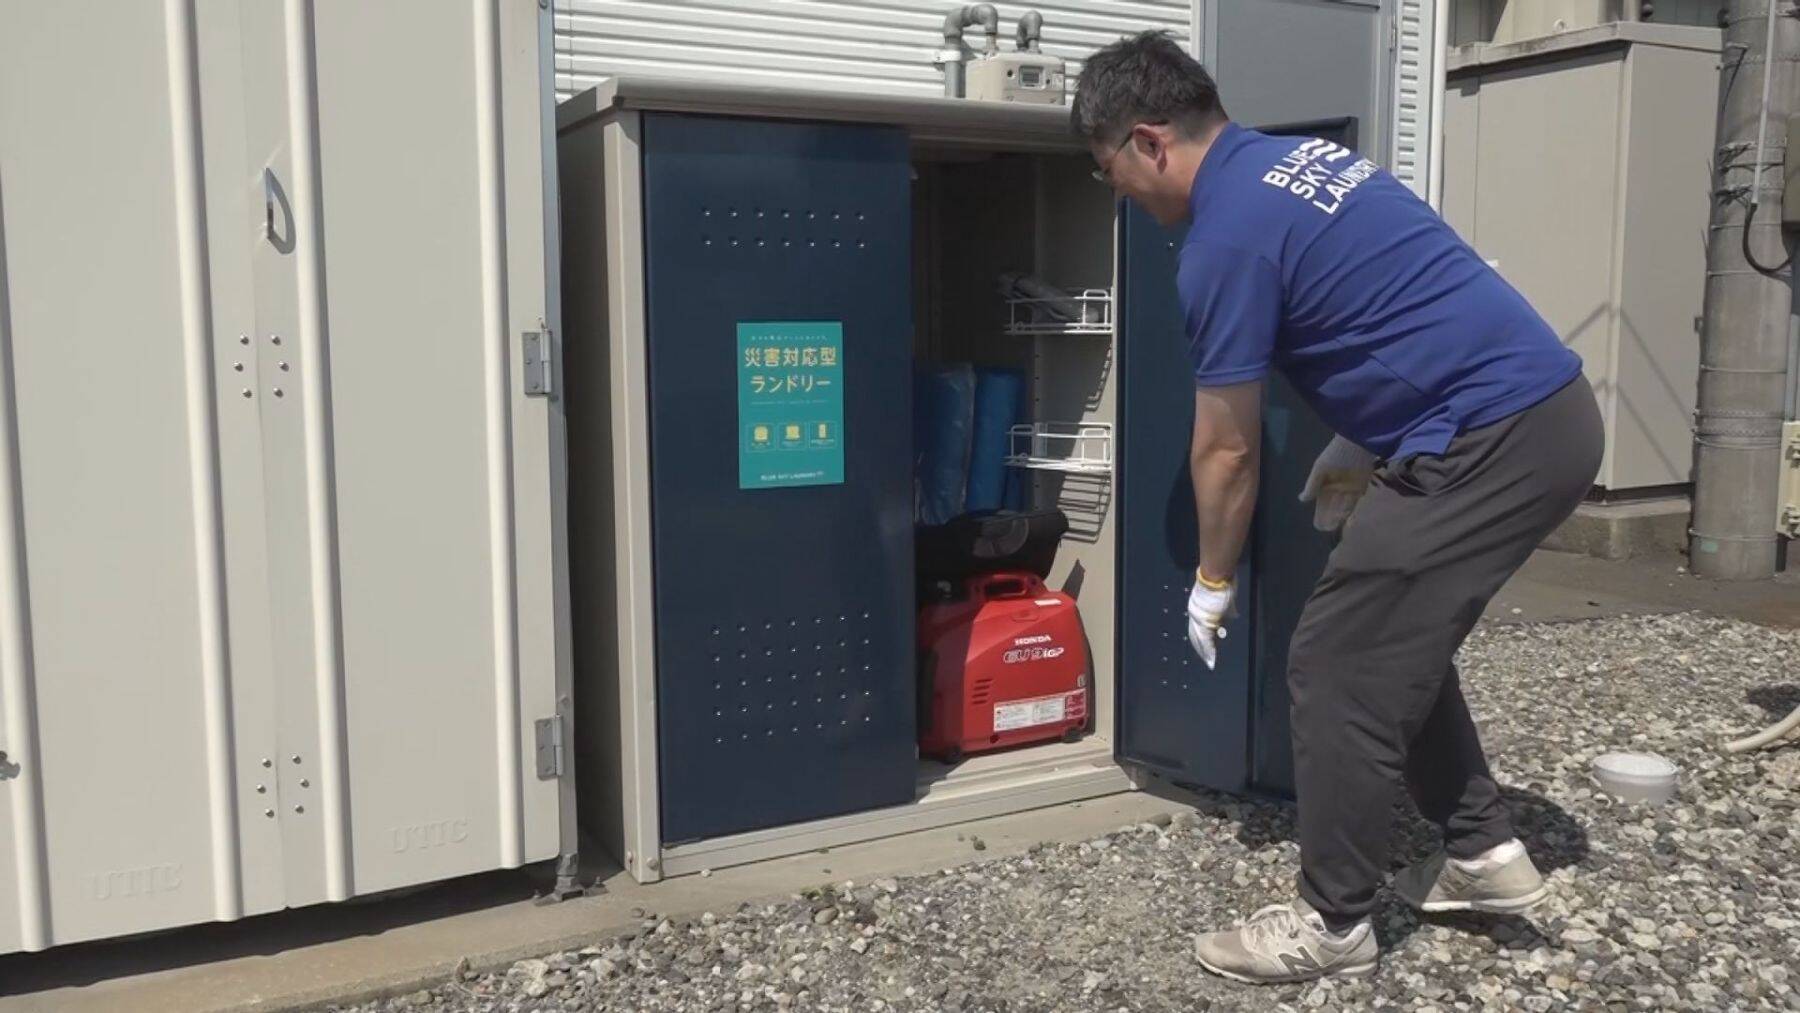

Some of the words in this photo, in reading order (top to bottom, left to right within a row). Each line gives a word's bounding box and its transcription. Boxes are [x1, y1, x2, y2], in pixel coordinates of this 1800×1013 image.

[1290, 162, 1333, 200] SKY
[745, 347, 836, 367] 災害対応型
[751, 376, 830, 393] ランドリー
[1015, 635, 1051, 645] HONDA
[1278, 945, 1324, 976] N
